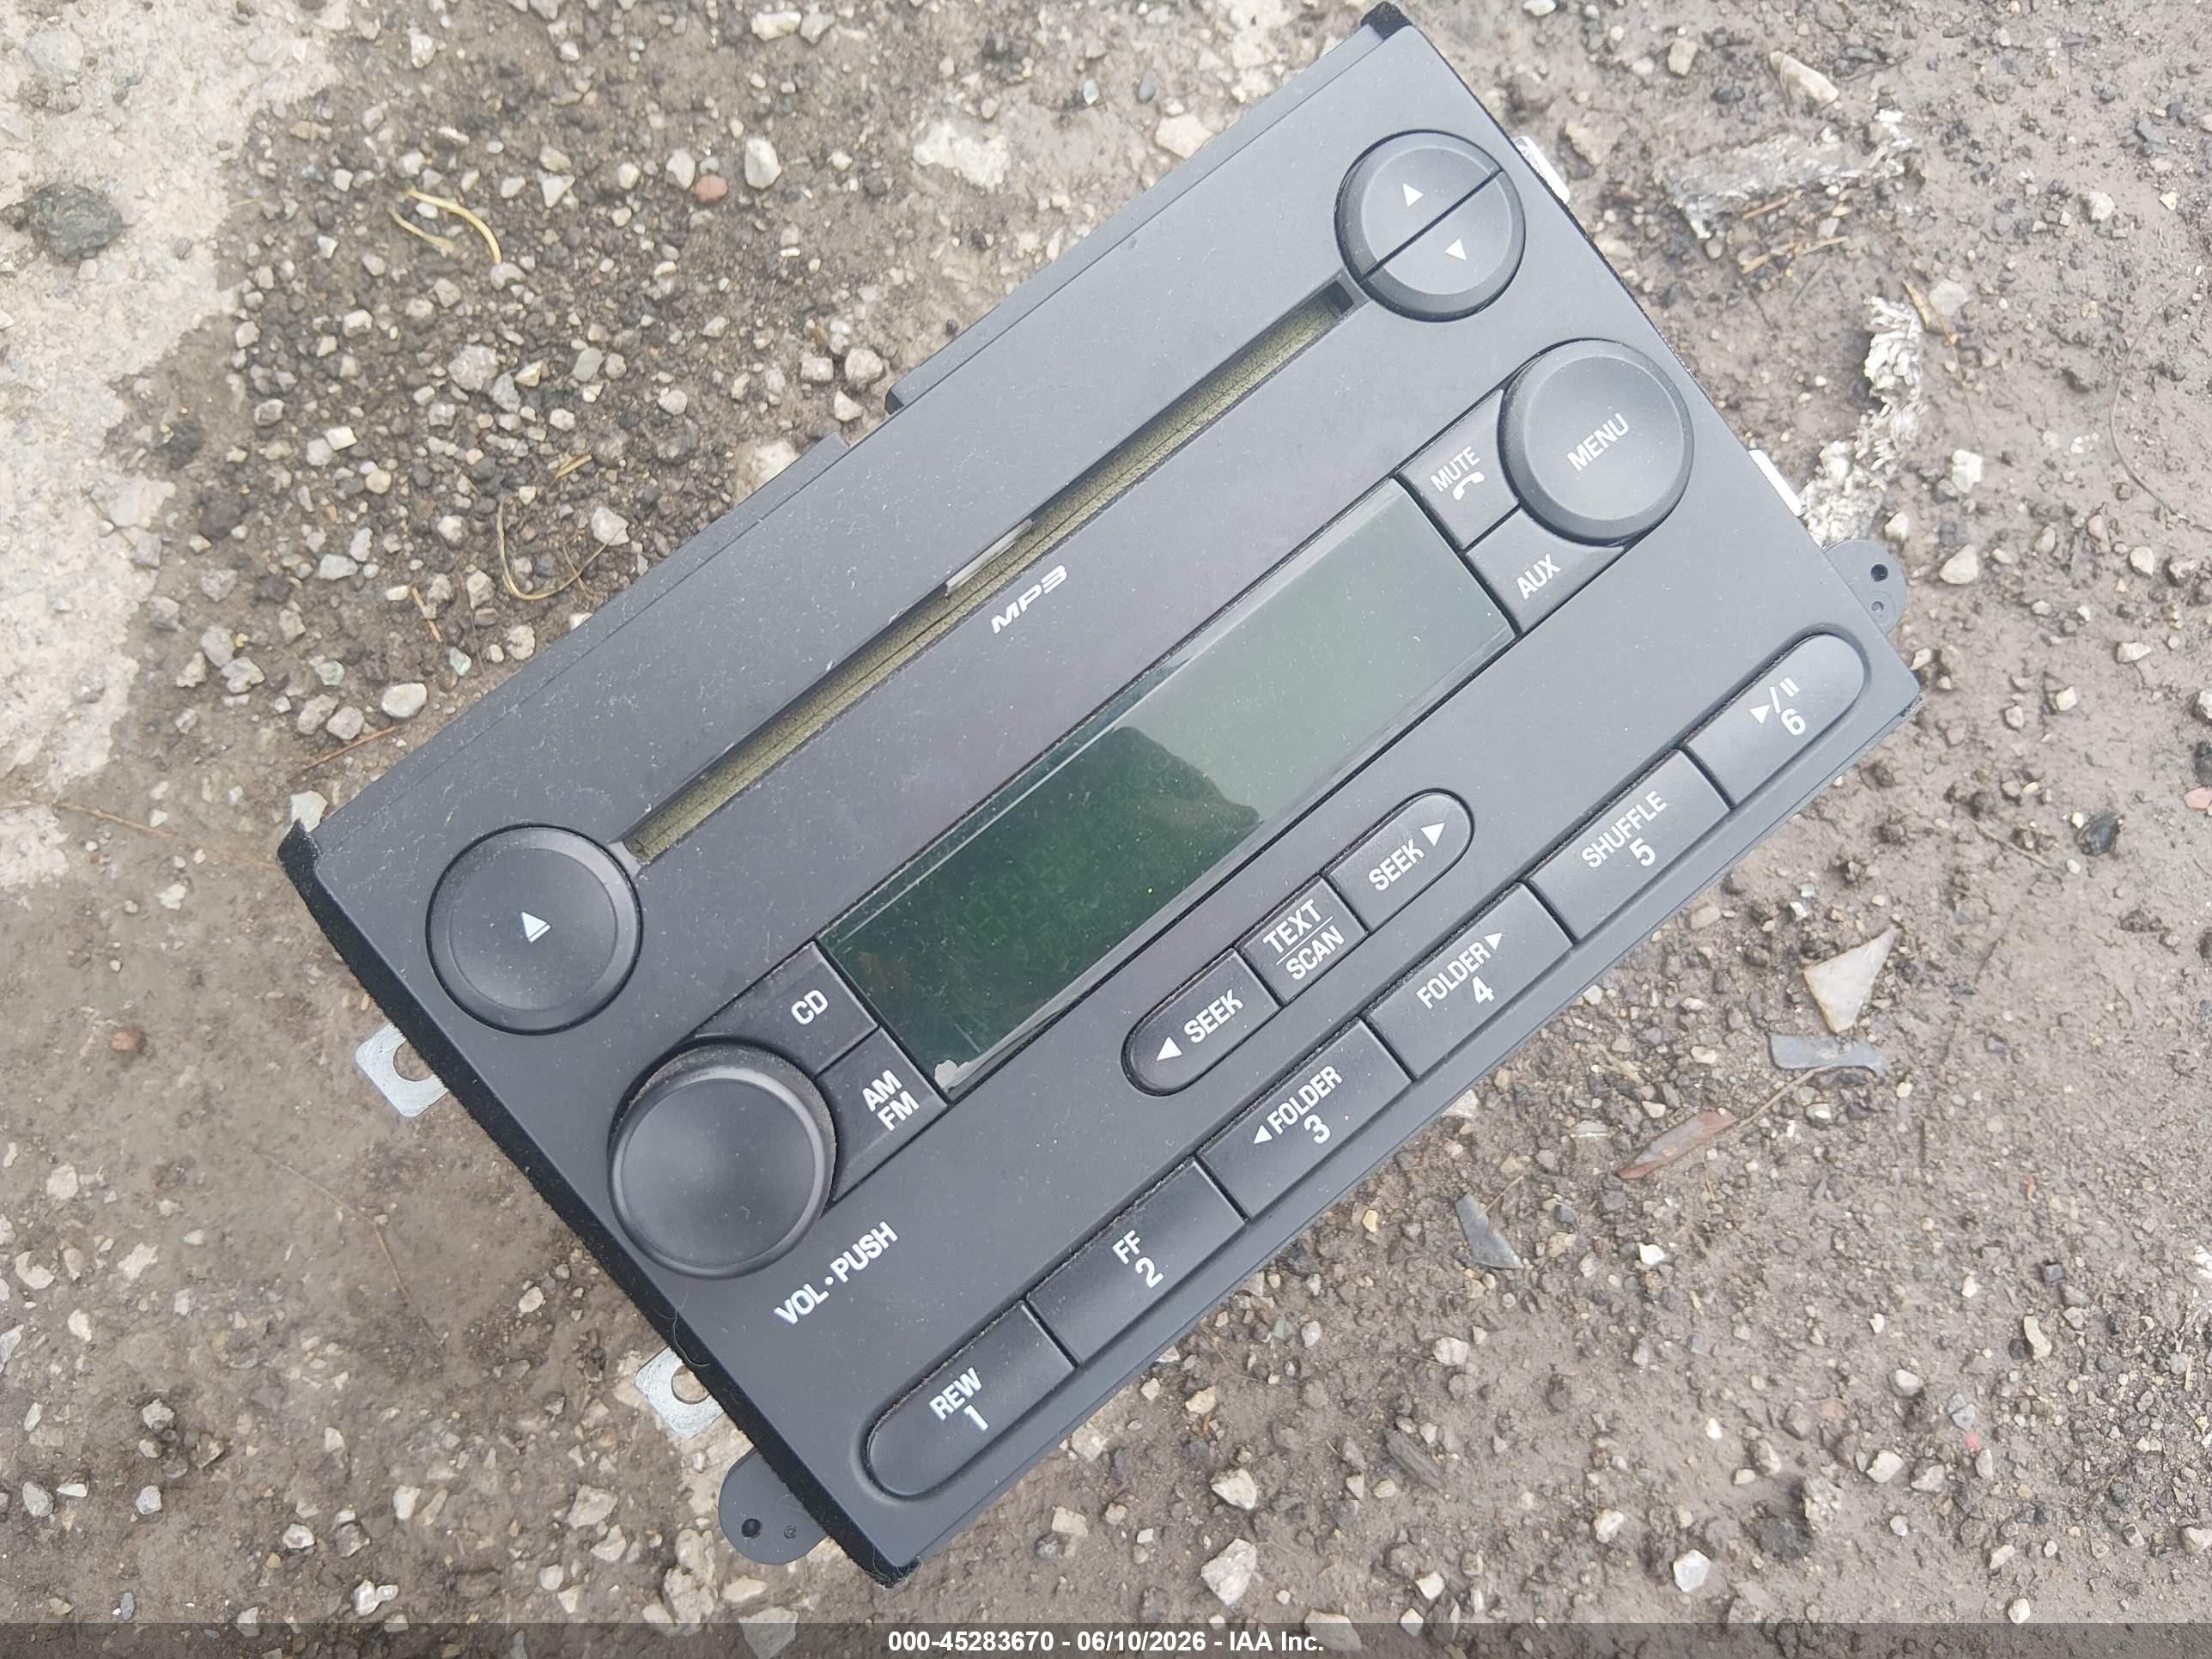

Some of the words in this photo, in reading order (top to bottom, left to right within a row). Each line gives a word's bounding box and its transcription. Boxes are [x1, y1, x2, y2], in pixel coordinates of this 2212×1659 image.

[1567, 412, 1629, 471] MENU
[1431, 446, 1481, 492] MUTE
[1516, 554, 1561, 599] AUX
[991, 565, 1067, 634] MP3
[1781, 708, 1806, 736] 6
[1581, 791, 1668, 868] SHUFFLE
[1629, 837, 1656, 866] 5
[1368, 838, 1425, 891] SEEK
[1262, 898, 1322, 954] TEXT
[1285, 924, 1345, 981] SCAN
[1416, 942, 1492, 1010] FOLDER
[1472, 975, 1495, 1004] 4
[790, 989, 829, 1025] CD
[1183, 988, 1243, 1043] SEEK
[862, 1069, 902, 1112] AM
[877, 1090, 920, 1132] FM
[1267, 1066, 1343, 1134] FOLDER
[1304, 1114, 1331, 1144] 3
[1112, 1230, 1144, 1265] FF
[1134, 1256, 1164, 1289] 2
[928, 1367, 982, 1422] REW
[963, 1404, 989, 1431] 1
